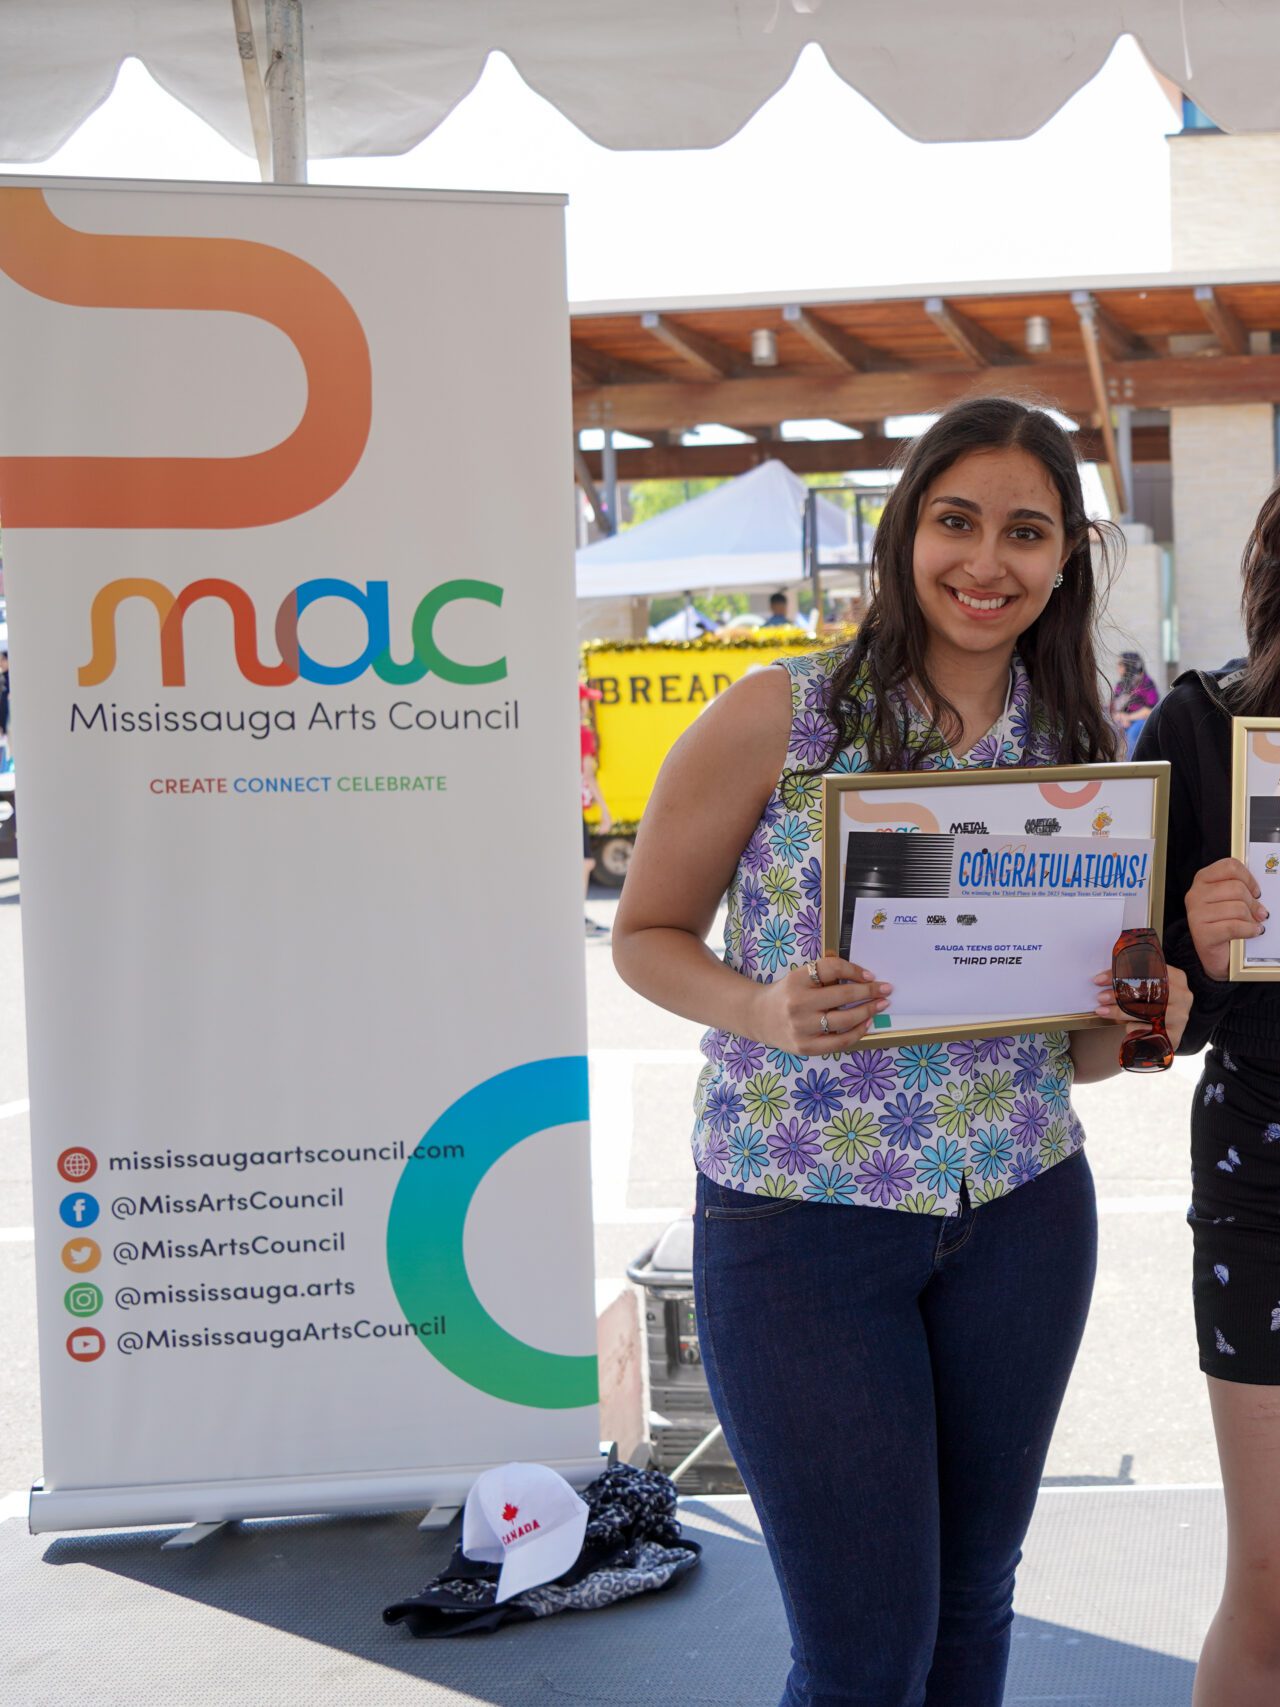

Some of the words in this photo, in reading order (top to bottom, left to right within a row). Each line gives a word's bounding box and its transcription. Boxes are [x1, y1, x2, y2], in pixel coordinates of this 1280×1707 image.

[77, 577, 508, 688] mac
[70, 703, 297, 740] Mississauga
[308, 702, 377, 732] Arts
[389, 701, 520, 731] Council
[150, 778, 228, 795] CREATE
[233, 777, 332, 794] CONNECT
[337, 776, 448, 793] CELEBRATE
[949, 821, 989, 833] METAL
[958, 850, 1148, 889] CONGRATULATIONS!
[953, 956, 987, 965] THIRD
[990, 956, 1023, 965] PRIZE
[109, 1141, 465, 1173] mississaugaartscouncil.com
[111, 1188, 344, 1220] @MissArtsCouncil
[113, 1233, 345, 1265] @MissArtsCouncil
[115, 1278, 355, 1310] @mississauga.arts
[117, 1316, 446, 1355] @MississaugaArtsCouncil
[502, 1519, 541, 1546] CANADA
